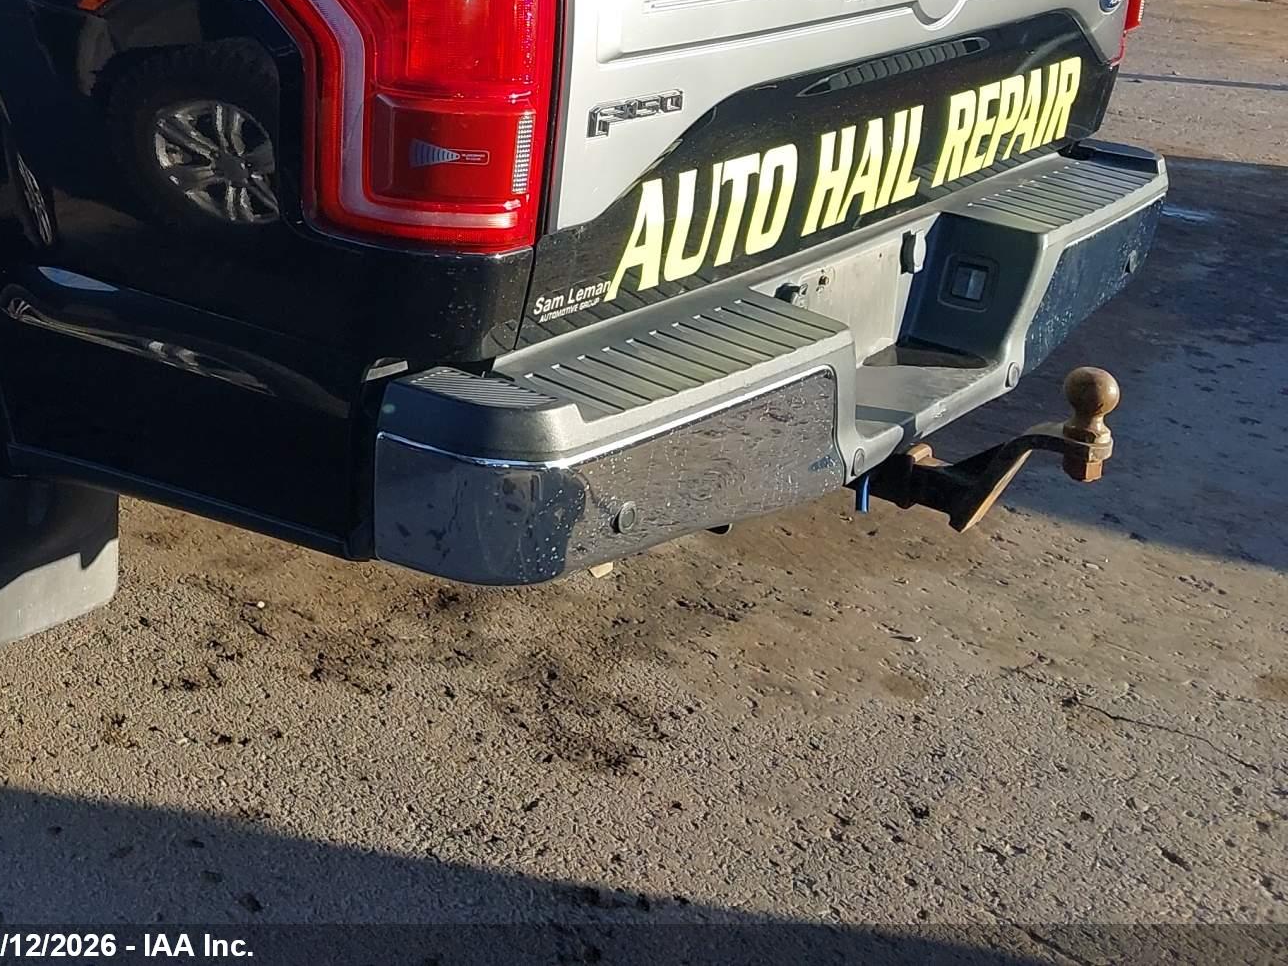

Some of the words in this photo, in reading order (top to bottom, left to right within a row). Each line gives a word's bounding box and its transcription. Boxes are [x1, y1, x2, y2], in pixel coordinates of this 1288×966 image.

[604, 143, 799, 303] AUTO
[801, 105, 925, 237] HAIL
[930, 56, 1082, 188] REPAIR
[533, 294, 564, 314] Sam
[568, 280, 613, 304] Leman
[539, 302, 578, 323] AUTOMOTIVE
[579, 297, 601, 311] GROUP
